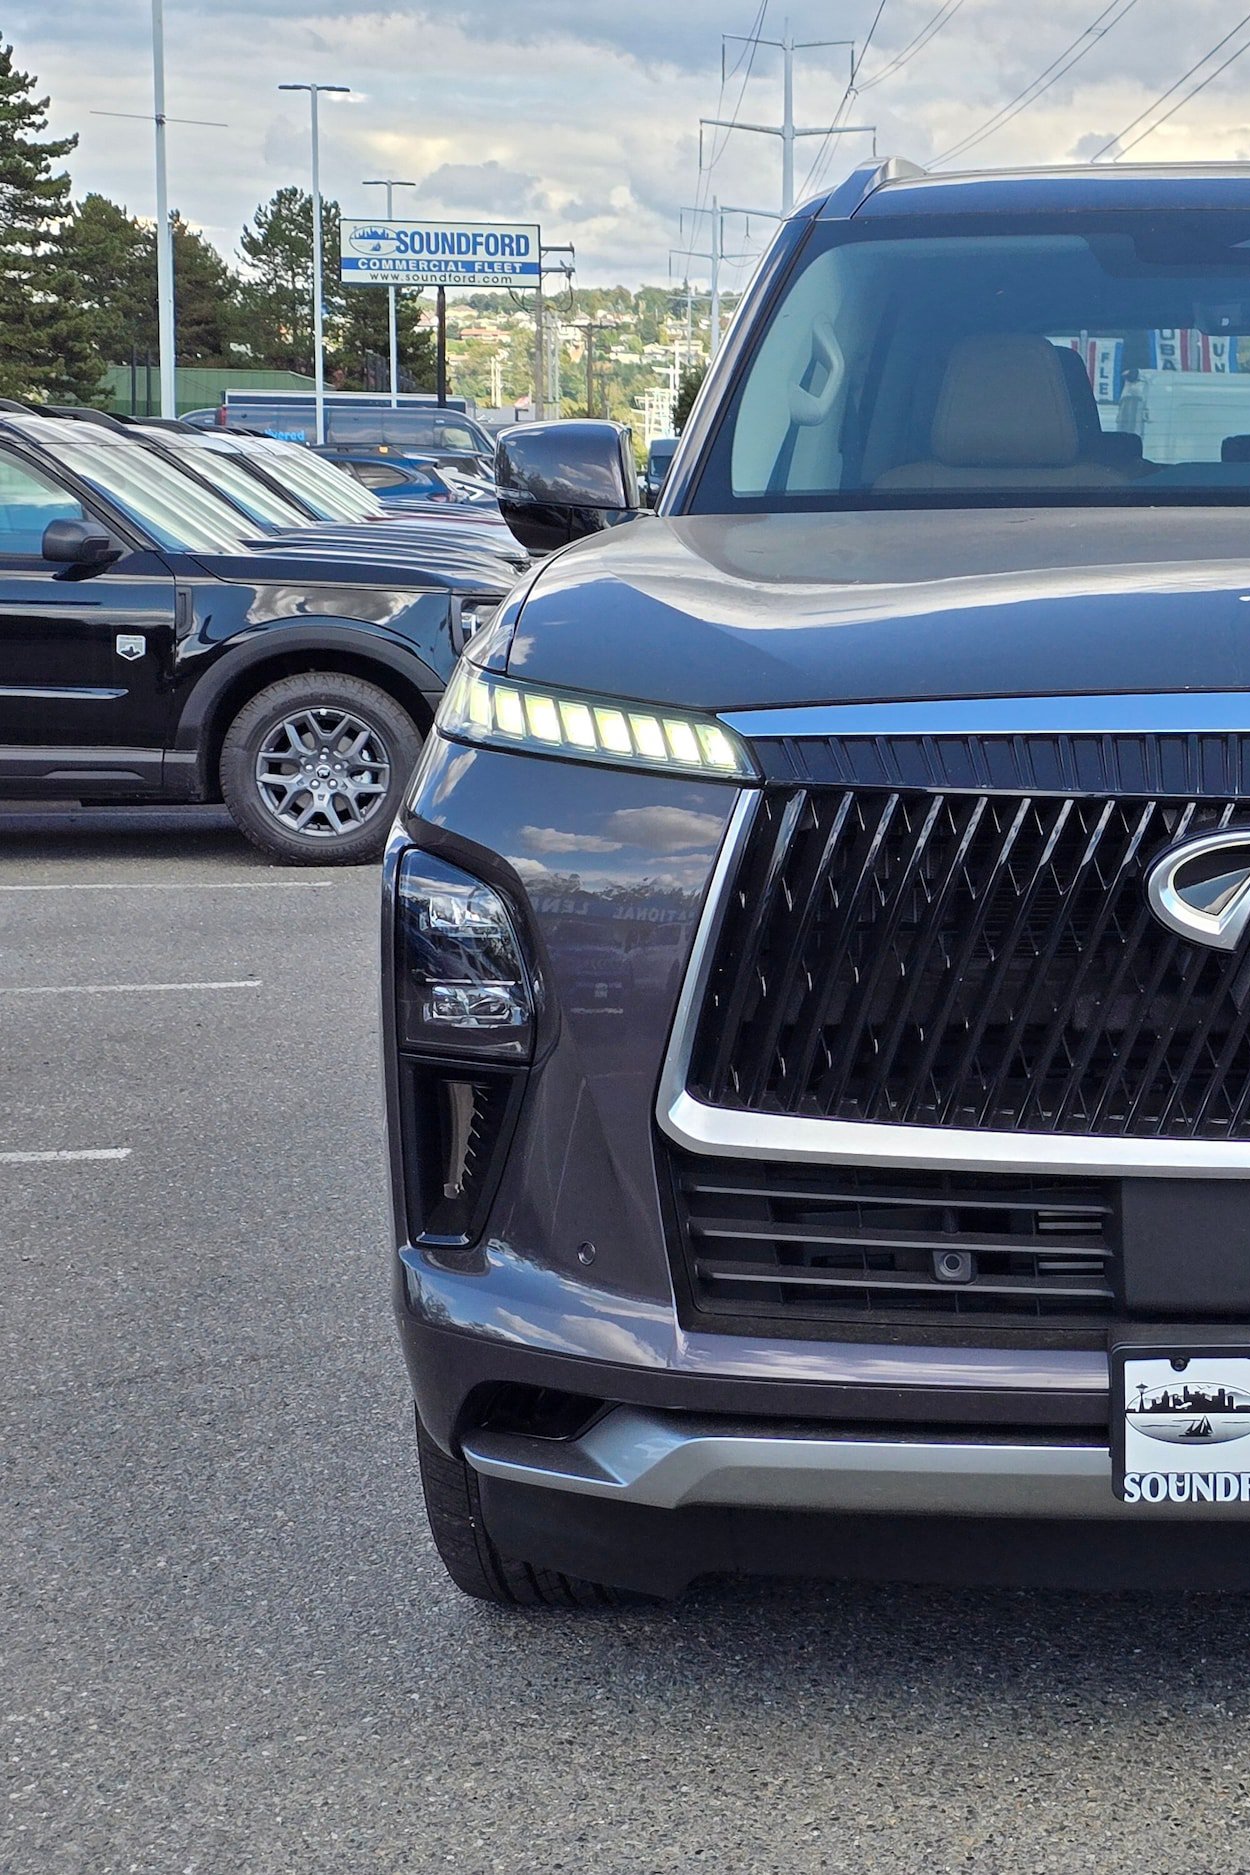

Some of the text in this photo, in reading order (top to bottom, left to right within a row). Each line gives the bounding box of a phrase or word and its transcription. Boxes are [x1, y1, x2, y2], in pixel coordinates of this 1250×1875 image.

[395, 230, 530, 257] SOUNDFORD
[358, 258, 522, 274] COMMERCIAL FLEET
[369, 273, 513, 285] www.soundford.com
